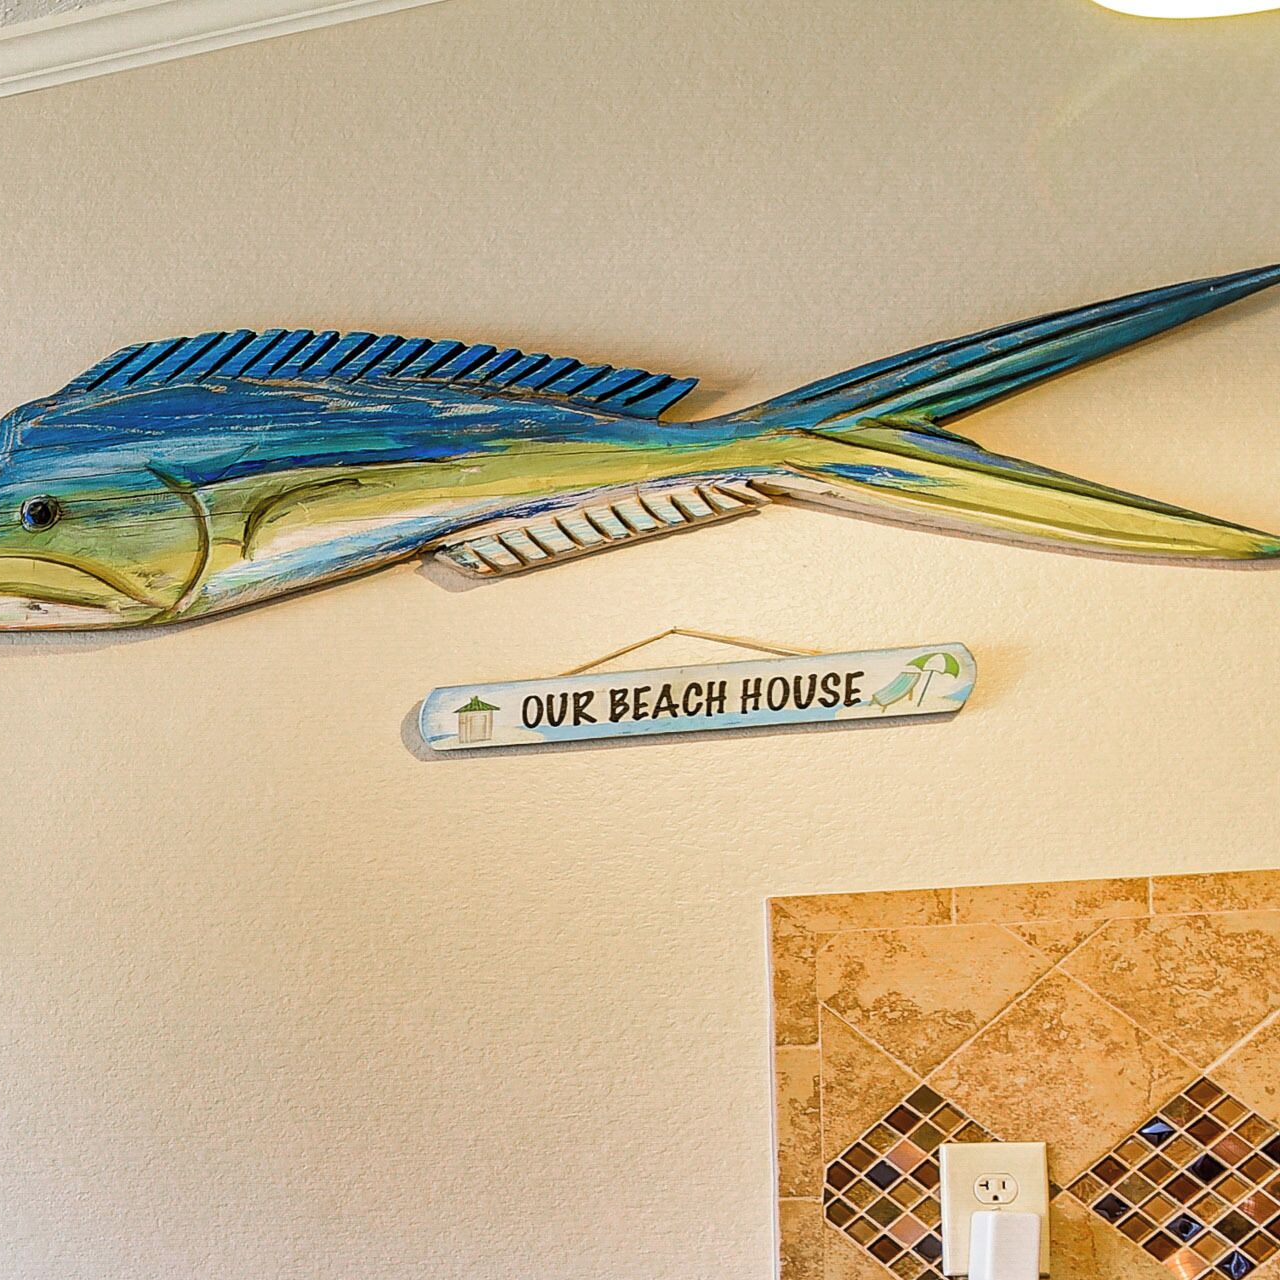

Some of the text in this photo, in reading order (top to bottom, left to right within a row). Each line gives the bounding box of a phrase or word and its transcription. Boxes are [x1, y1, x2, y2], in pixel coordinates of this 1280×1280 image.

[522, 671, 866, 731] OUR BEACH HOUSE
